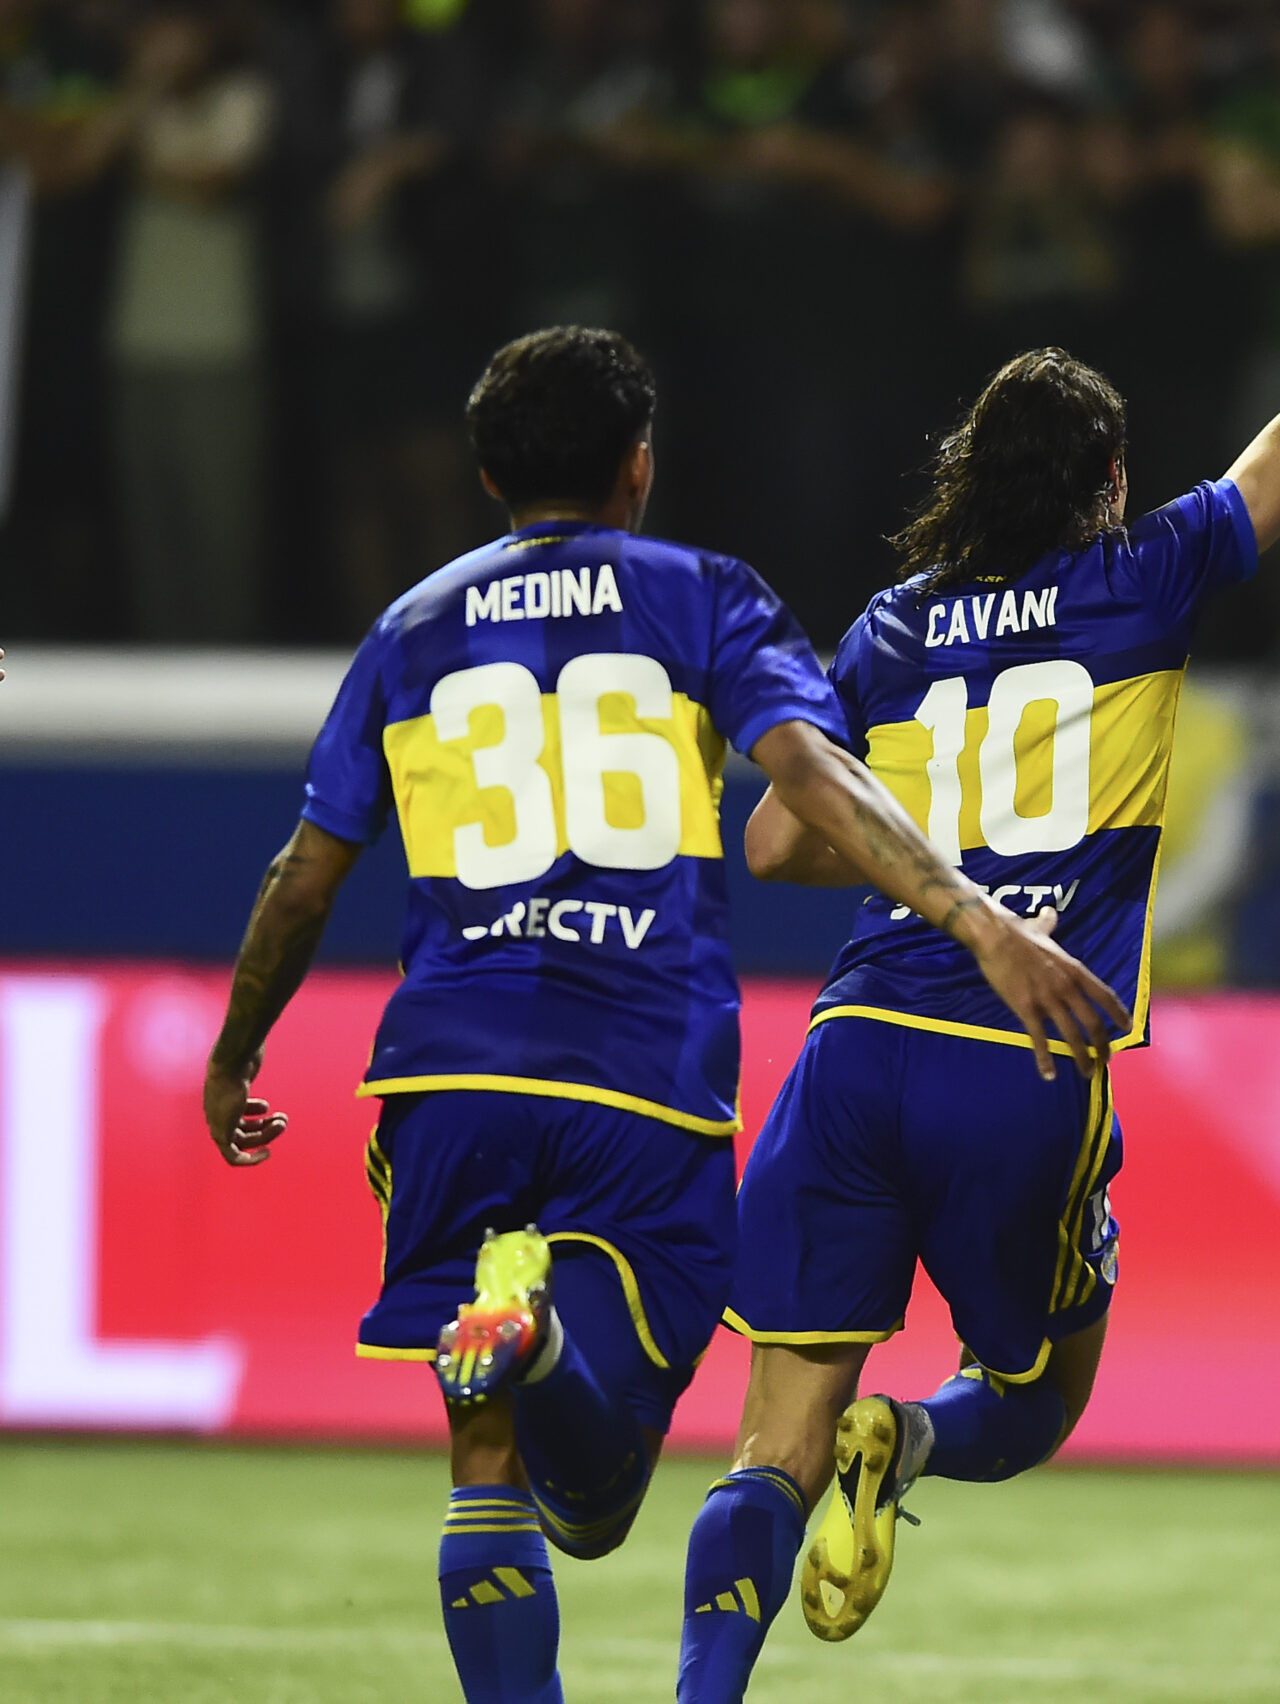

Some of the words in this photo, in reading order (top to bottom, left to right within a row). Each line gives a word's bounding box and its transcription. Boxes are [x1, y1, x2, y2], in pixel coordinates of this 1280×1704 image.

[465, 564, 623, 626] MEDINA
[924, 586, 1058, 648] CAVANI
[430, 652, 682, 890] 36
[914, 659, 1094, 867] 10
[462, 898, 657, 950] RECTV
